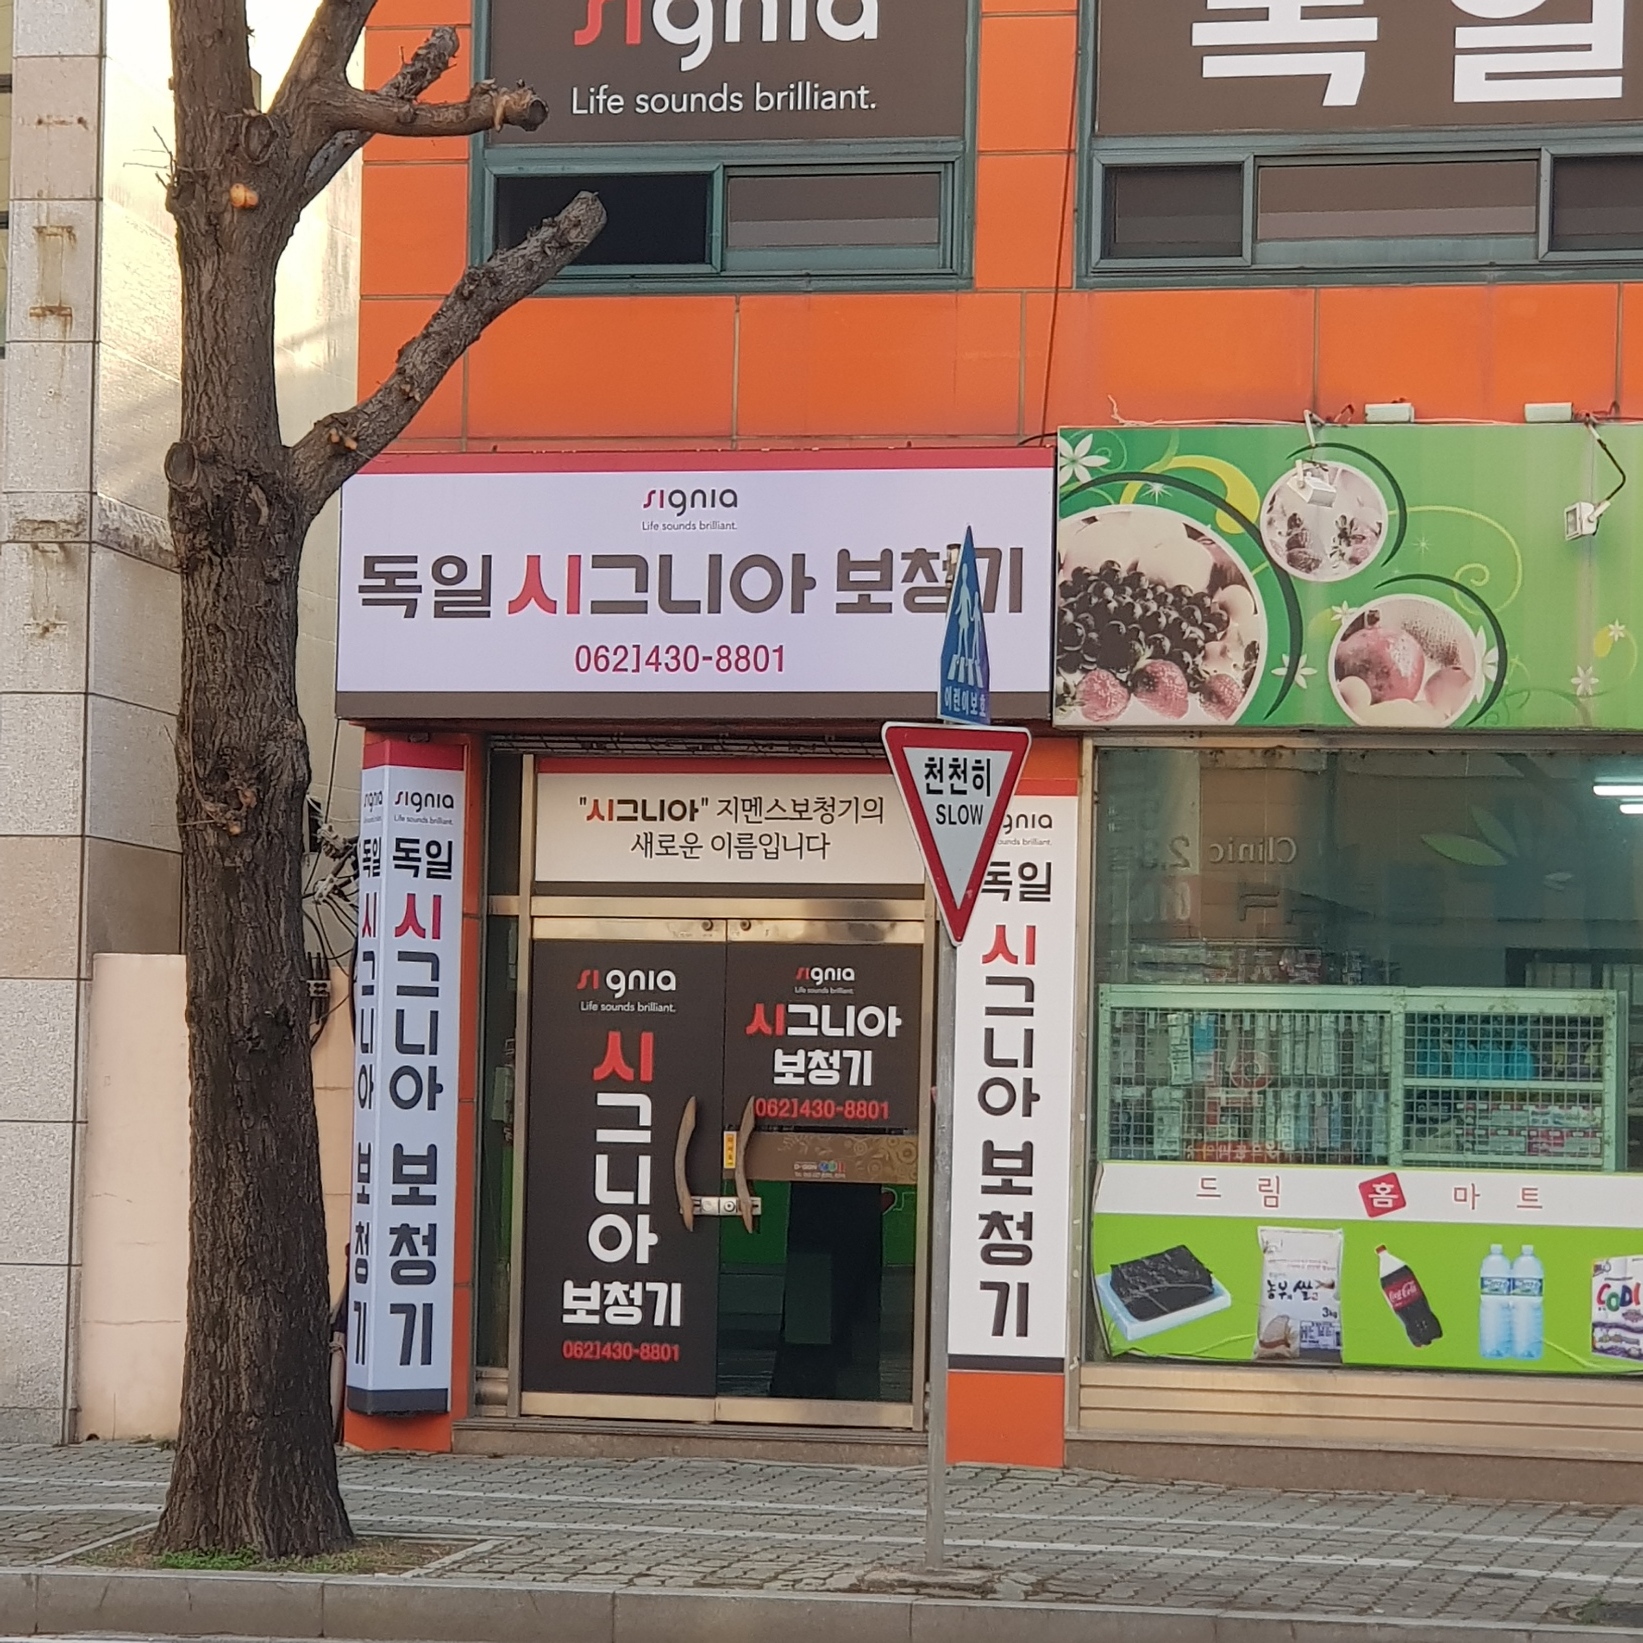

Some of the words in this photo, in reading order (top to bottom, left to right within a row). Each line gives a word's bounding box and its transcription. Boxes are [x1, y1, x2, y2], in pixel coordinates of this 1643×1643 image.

[572, 84, 624, 115] Life
[635, 83, 743, 113] sounds
[755, 81, 876, 111] brilliant.
[643, 489, 738, 517] signia
[642, 521, 659, 531] Life
[662, 521, 696, 530] sounds
[699, 520, 737, 530] brilliant.
[358, 554, 493, 619] 독일
[508, 553, 817, 615] 시그니아
[575, 644, 784, 673] 062]430-8801
[924, 756, 991, 797] 천천히
[394, 791, 455, 813] signia
[579, 796, 708, 822] "시그니아"
[716, 796, 885, 824] 지멘스보청기의
[936, 804, 984, 825] SLOW
[1002, 813, 1052, 834] gnia
[393, 837, 453, 879] 독일
[631, 831, 704, 860] 새로운
[711, 831, 831, 860] 이름입니다
[981, 861, 1053, 902] 독일
[577, 969, 677, 998] signia
[796, 967, 855, 985] signia
[580, 1001, 598, 1011] Life
[600, 1002, 634, 1012] sounds
[637, 1002, 676, 1013] brilliant.
[745, 1003, 902, 1037] 시그니아
[773, 1048, 872, 1086] 보청기
[755, 1098, 889, 1120] 062]430-8801
[562, 1280, 682, 1327] 보청기
[562, 1340, 681, 1362] 062]430-8801
